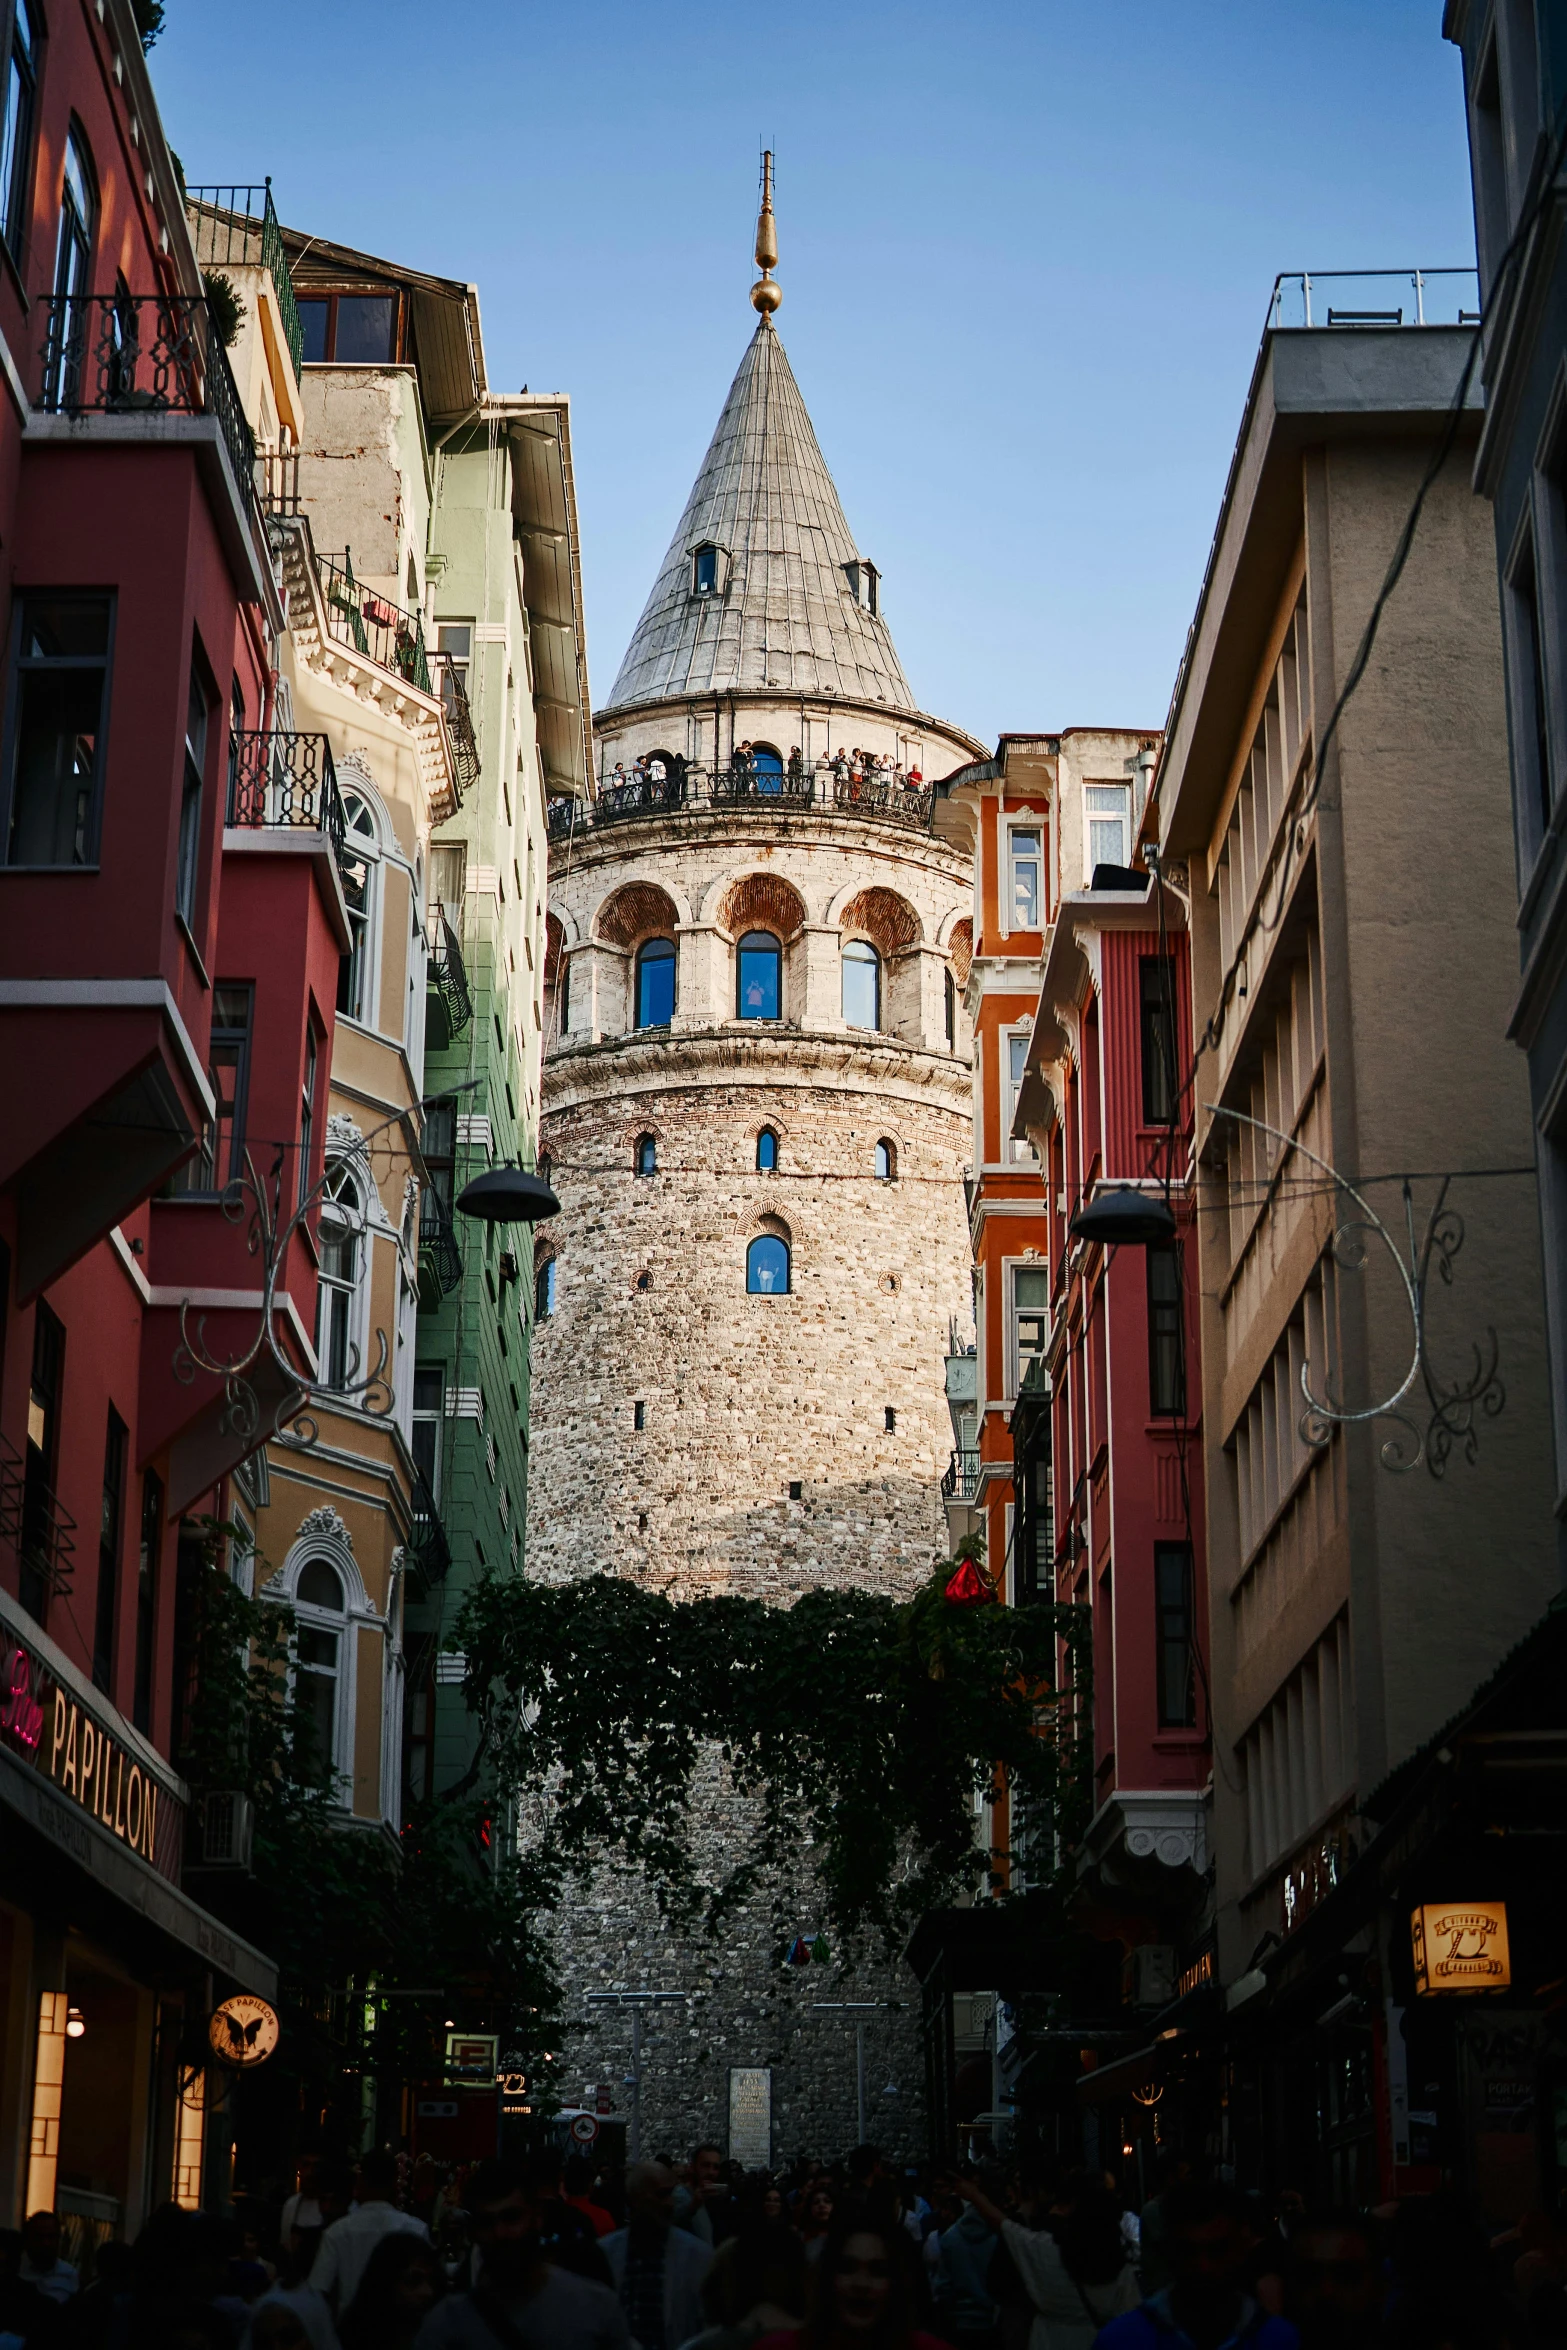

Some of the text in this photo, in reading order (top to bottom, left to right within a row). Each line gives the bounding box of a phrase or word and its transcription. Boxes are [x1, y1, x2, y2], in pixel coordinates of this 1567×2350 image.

[51, 1687, 158, 1862] PAPILLON
[214, 1998, 275, 2027] ROSE PAPILLON
